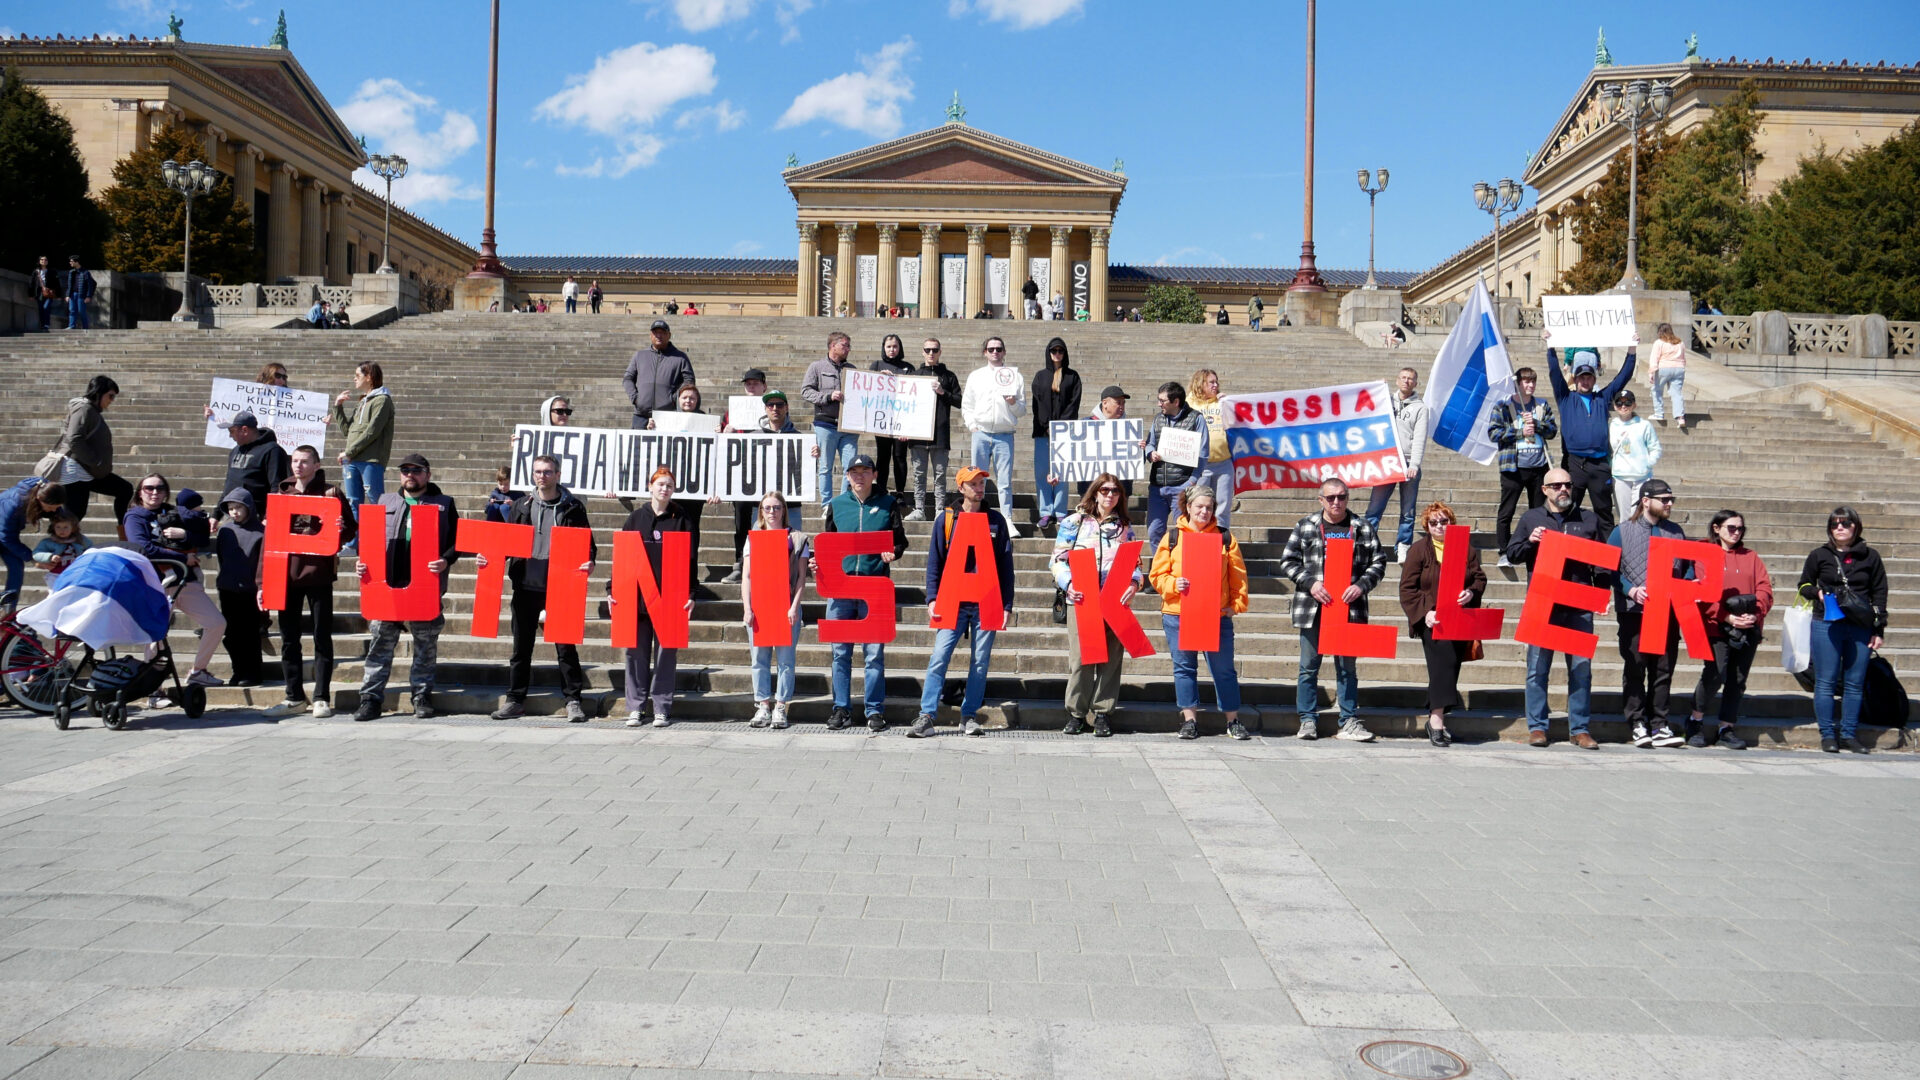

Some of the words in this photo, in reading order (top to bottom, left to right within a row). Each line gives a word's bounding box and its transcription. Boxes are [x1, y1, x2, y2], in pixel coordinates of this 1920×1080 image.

[867, 259, 875, 290] Stephen
[910, 261, 918, 293] Outsider
[1074, 264, 1087, 289] ON
[1040, 277, 1048, 300] Origin
[1074, 292, 1087, 320] VIE
[1567, 310, 1582, 327] НЕ
[1586, 309, 1634, 327] ПУТИН
[236, 384, 277, 397] PUTIN
[281, 392, 293, 400] IS
[297, 394, 306, 402] A
[852, 372, 917, 396] RUSSIA
[211, 401, 241, 412] AND
[245, 405, 254, 413] A
[259, 408, 325, 423] SCHMUCK
[247, 396, 294, 409] KILLER
[861, 394, 917, 413] without
[1234, 389, 1375, 425] RUSSIA
[287, 425, 322, 437] THINKS
[874, 410, 901, 431] Putin
[1051, 421, 1142, 441] PUTIN
[1051, 441, 1142, 461] KILLED
[1232, 422, 1389, 458] AGAINST
[514, 429, 607, 490] RUSSIA
[619, 435, 714, 494] WITHOUT
[726, 439, 802, 496] PUTIN
[262, 494, 690, 648] PUTIN
[749, 528, 896, 647] IS
[930, 512, 1004, 631] A
[1069, 526, 1724, 665] KILLER
